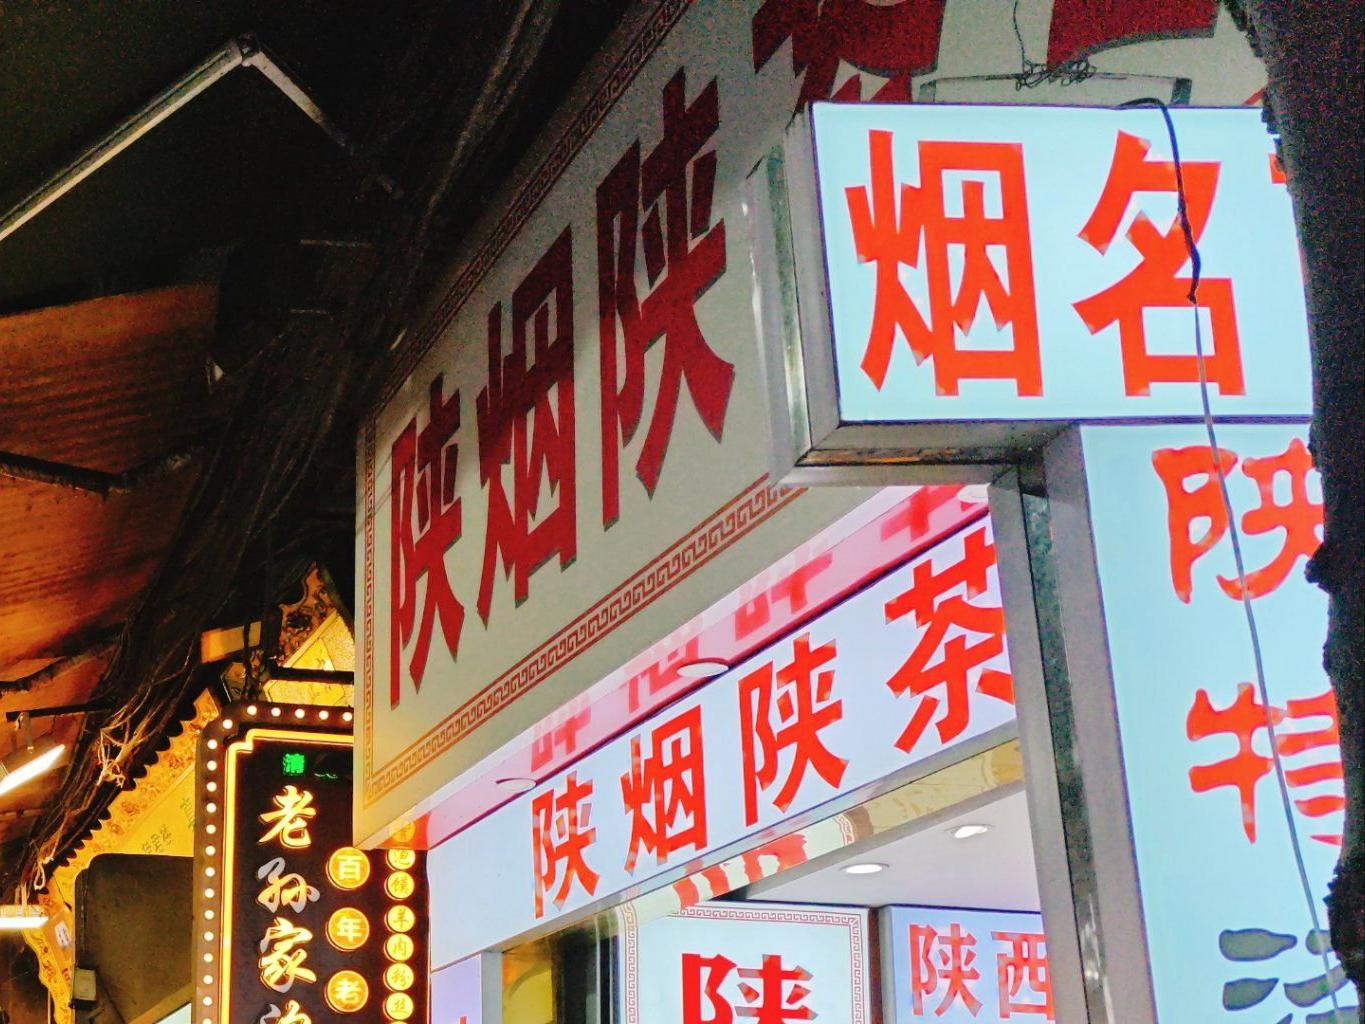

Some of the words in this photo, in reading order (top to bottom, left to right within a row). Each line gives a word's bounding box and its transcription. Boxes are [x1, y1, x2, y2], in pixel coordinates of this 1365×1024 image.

[844, 129, 1286, 397] 烟名
[533, 527, 1016, 920] 陕烟陕茶
